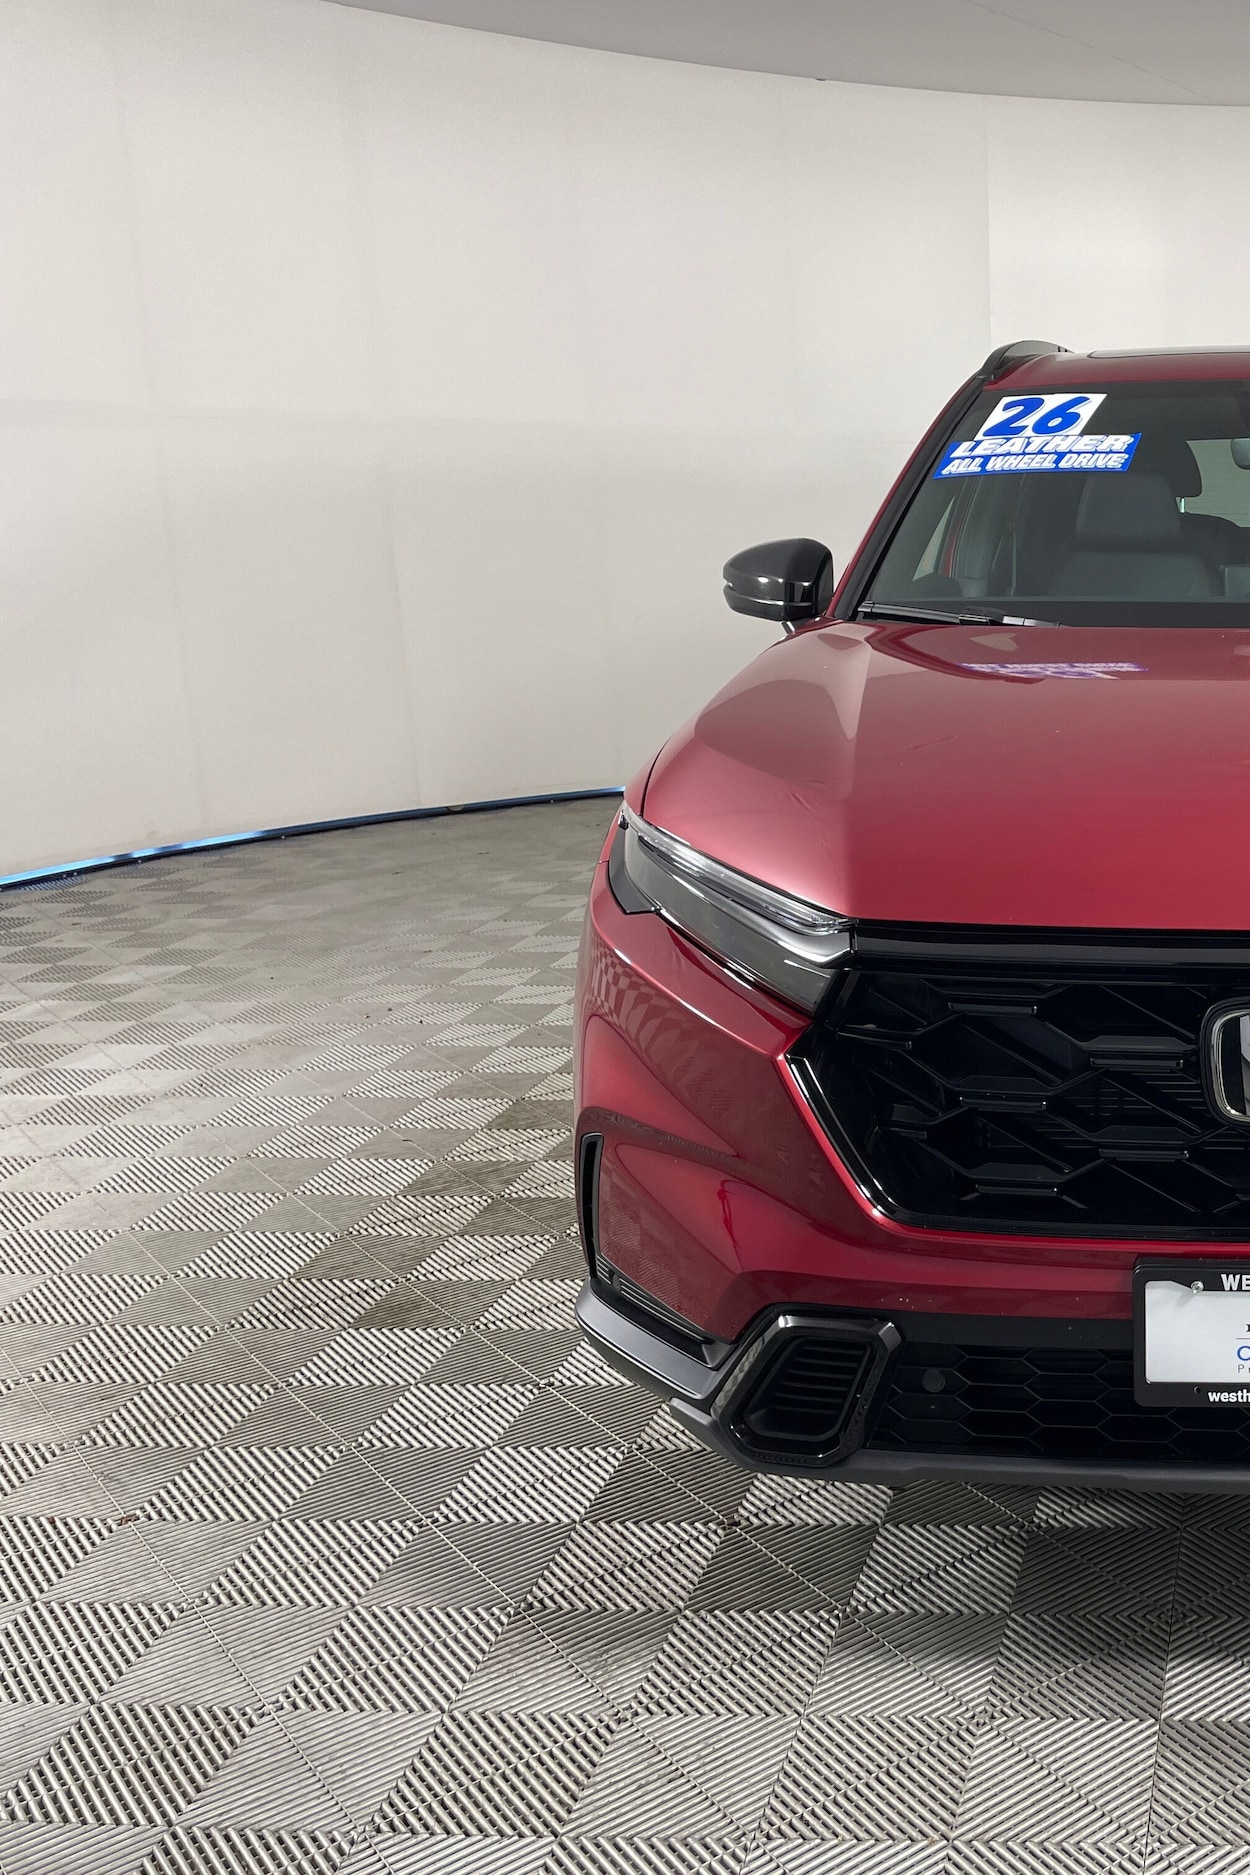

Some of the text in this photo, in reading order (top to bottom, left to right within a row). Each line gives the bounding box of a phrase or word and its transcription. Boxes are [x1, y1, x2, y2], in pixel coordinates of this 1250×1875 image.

[983, 396, 1091, 437] 26
[950, 435, 1134, 457] LEATHER
[941, 452, 1128, 474] ALL WHEEL DRIVE
